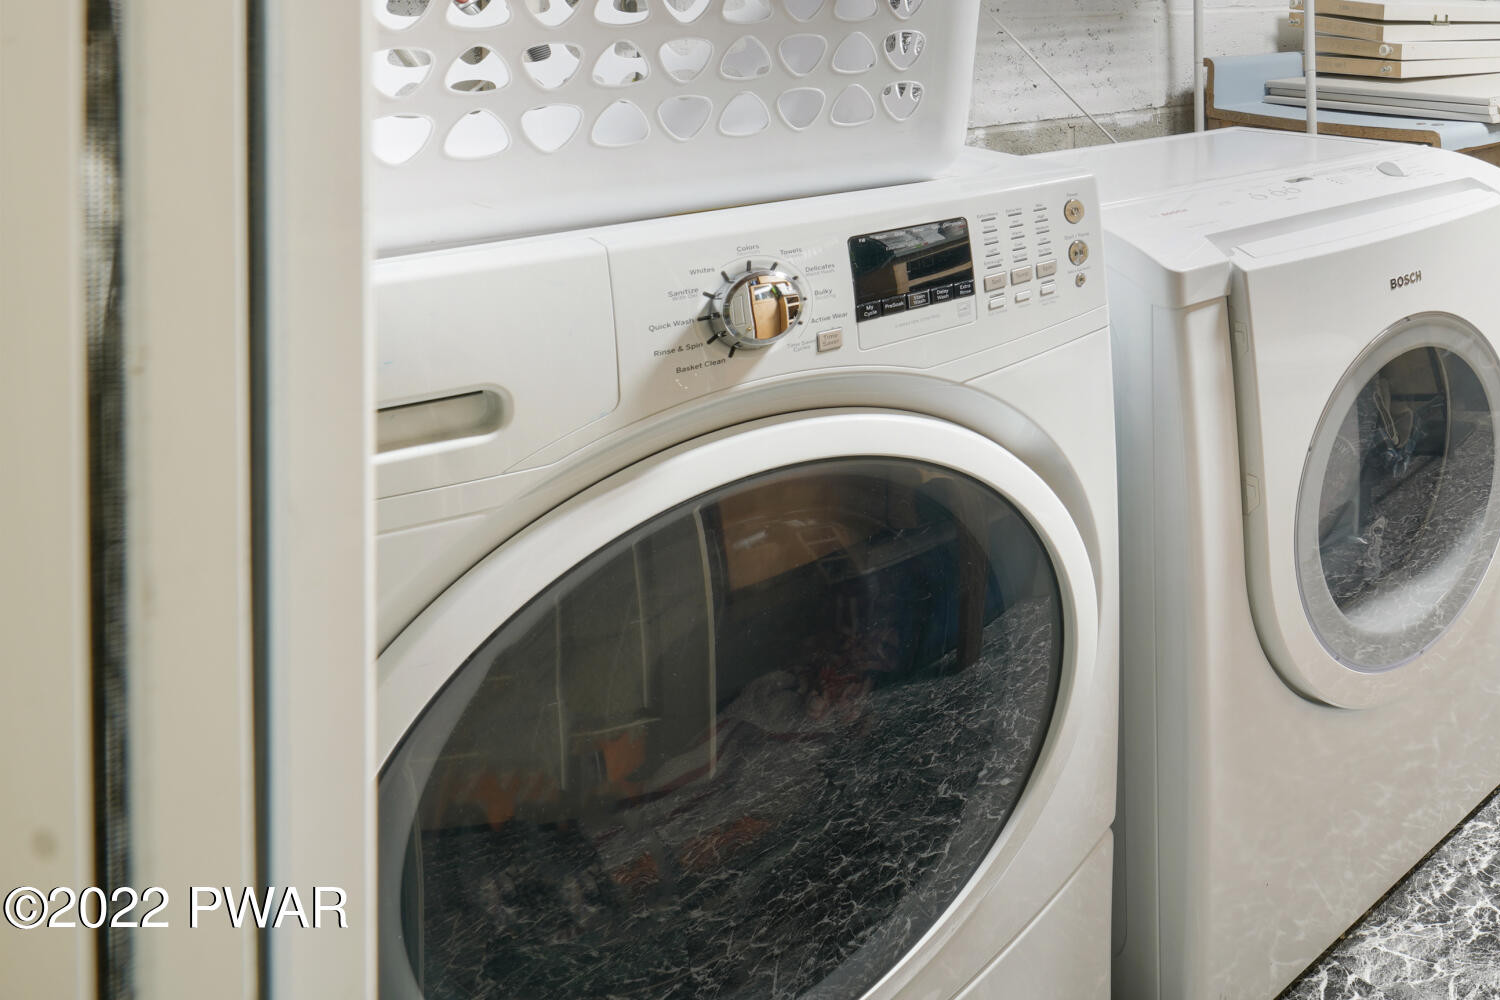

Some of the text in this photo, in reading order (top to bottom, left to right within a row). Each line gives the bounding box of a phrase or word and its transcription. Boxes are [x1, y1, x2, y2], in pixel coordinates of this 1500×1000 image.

[736, 243, 760, 253] Colors
[780, 247, 803, 256] Towels
[688, 266, 716, 276] Whites
[805, 262, 836, 273] Delicates
[1389, 269, 1423, 290] BOSCH
[666, 286, 699, 298] Sanitize
[814, 288, 833, 297] Bulky
[811, 311, 848, 323] Active Wear
[648, 317, 696, 333] Quick Wash
[653, 341, 704, 358] Rinse & Spin
[675, 357, 726, 374] Basket Clean
